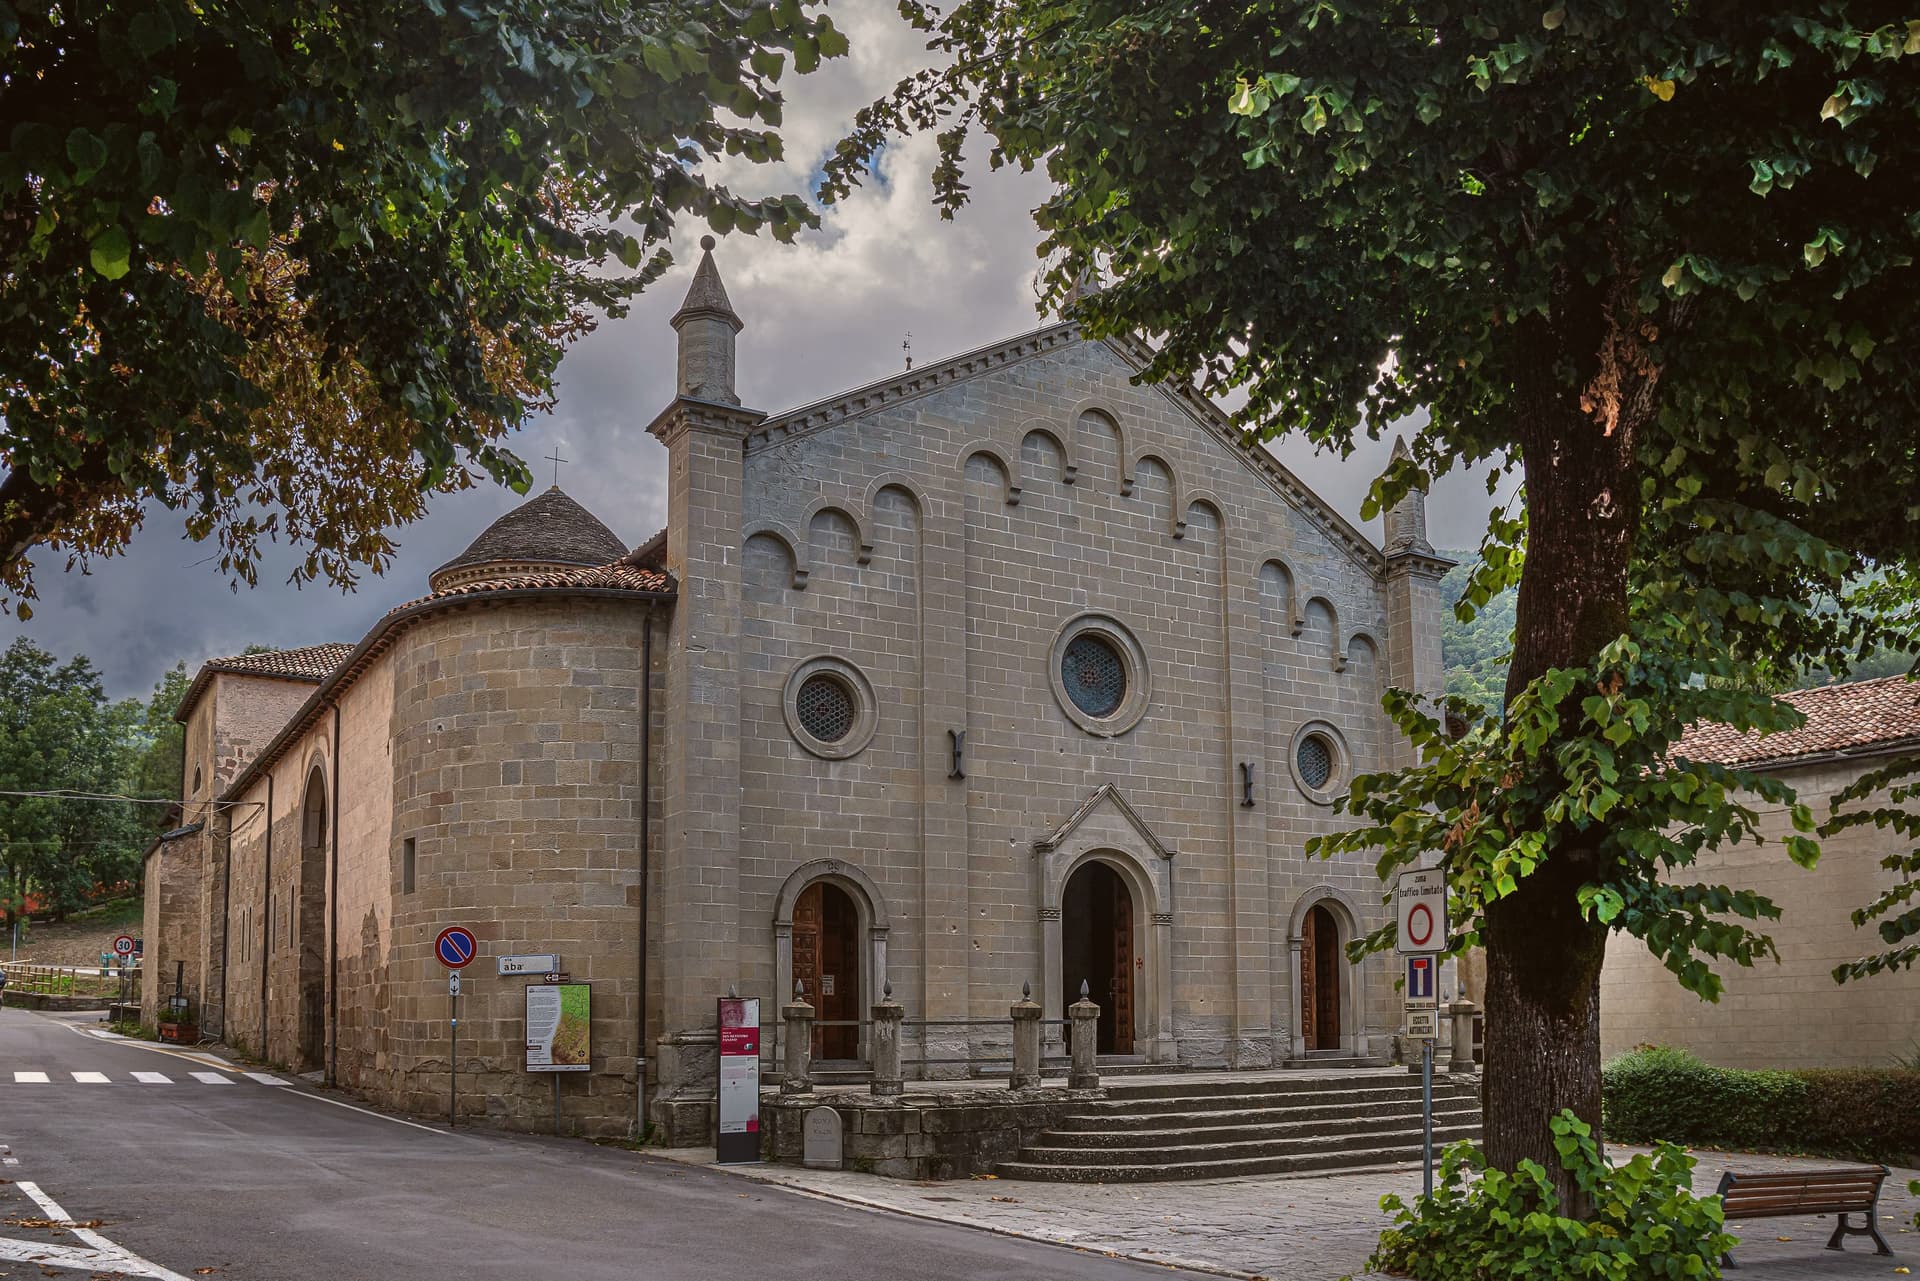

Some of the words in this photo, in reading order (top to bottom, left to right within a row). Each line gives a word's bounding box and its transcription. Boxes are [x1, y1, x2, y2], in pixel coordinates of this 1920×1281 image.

[1399, 887, 1419, 898] traffico
[1420, 884, 1443, 896] limitato
[118, 941, 131, 950] 30
